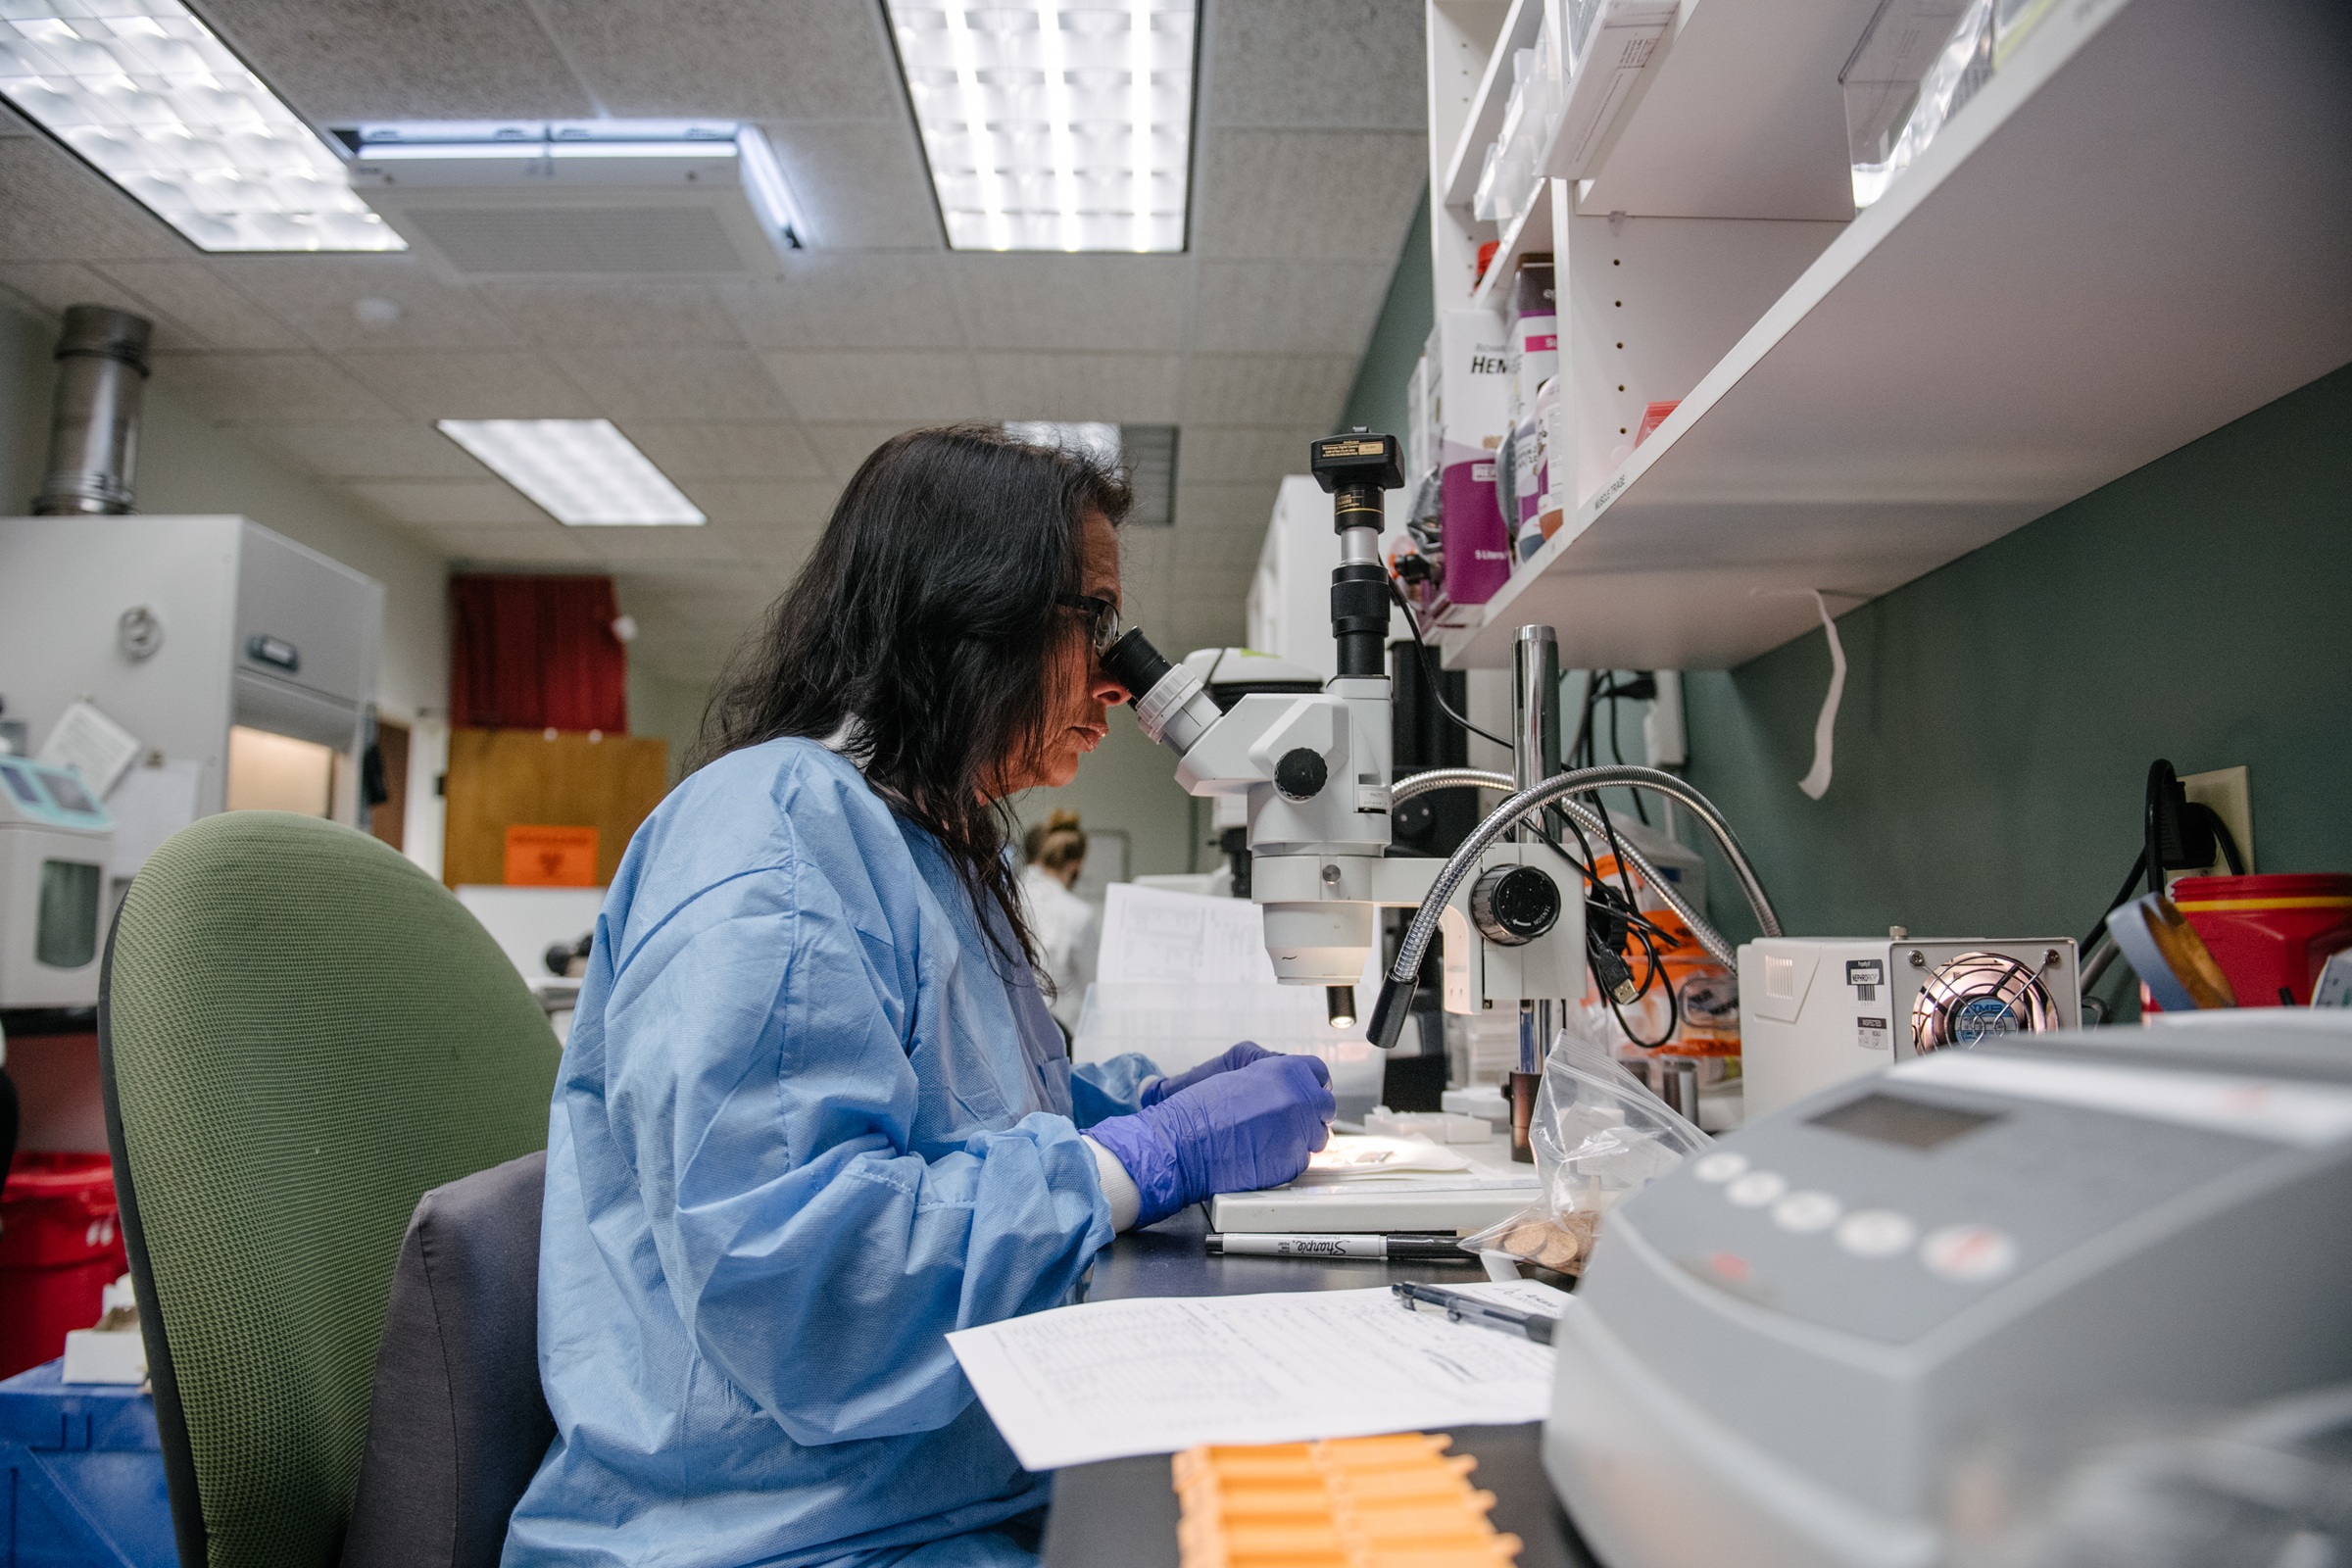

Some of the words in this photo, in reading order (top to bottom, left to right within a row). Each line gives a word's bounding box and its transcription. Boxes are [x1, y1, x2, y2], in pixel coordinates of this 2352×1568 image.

[1595, 489, 1610, 510] MUSCLE
[1610, 474, 1625, 492] TRIAGE
[1533, 904, 1551, 926] TENSION
[1295, 1240, 1350, 1255] Sharpie
